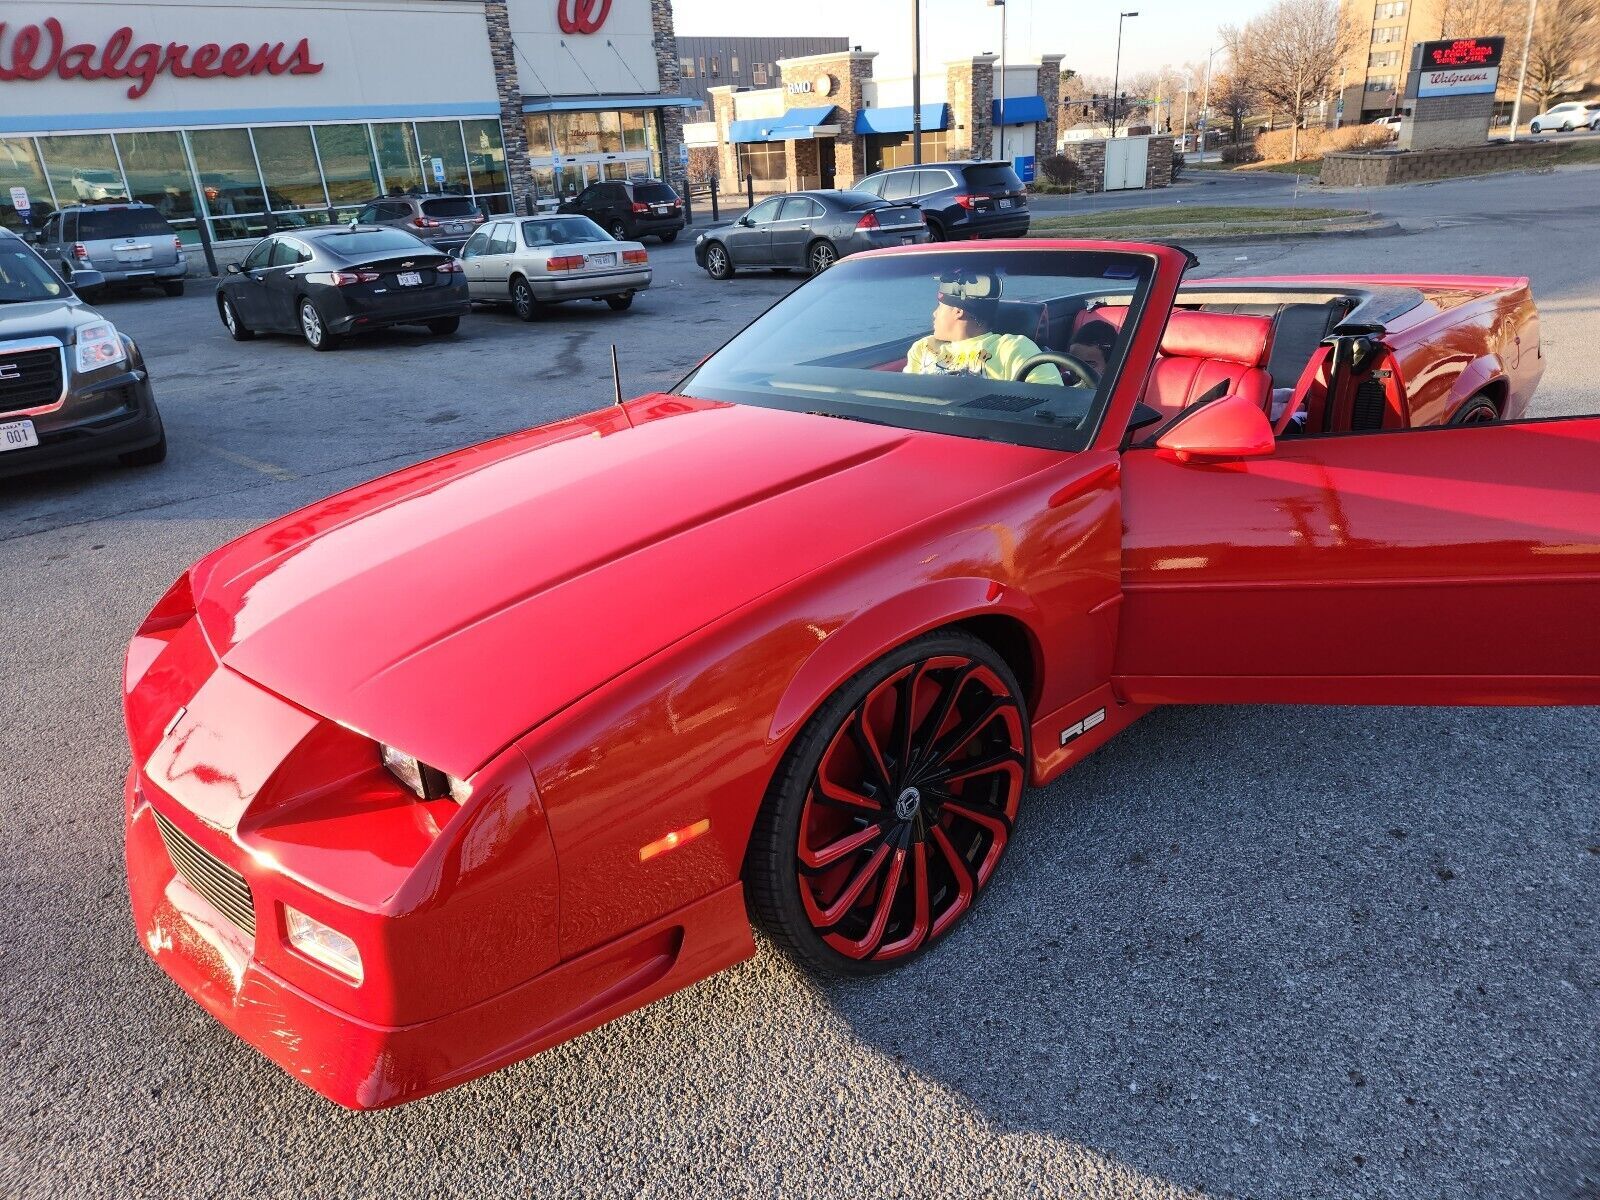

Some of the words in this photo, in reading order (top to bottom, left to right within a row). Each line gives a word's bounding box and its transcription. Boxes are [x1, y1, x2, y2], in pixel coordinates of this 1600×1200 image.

[1452, 40, 1476, 49] COKE
[0, 17, 324, 99] Walgreens
[1444, 48, 1467, 57] PACK
[1469, 46, 1492, 56] SODA
[1430, 72, 1488, 86] Walgreens
[787, 81, 811, 94] BMO
[1061, 708, 1105, 745] RS
